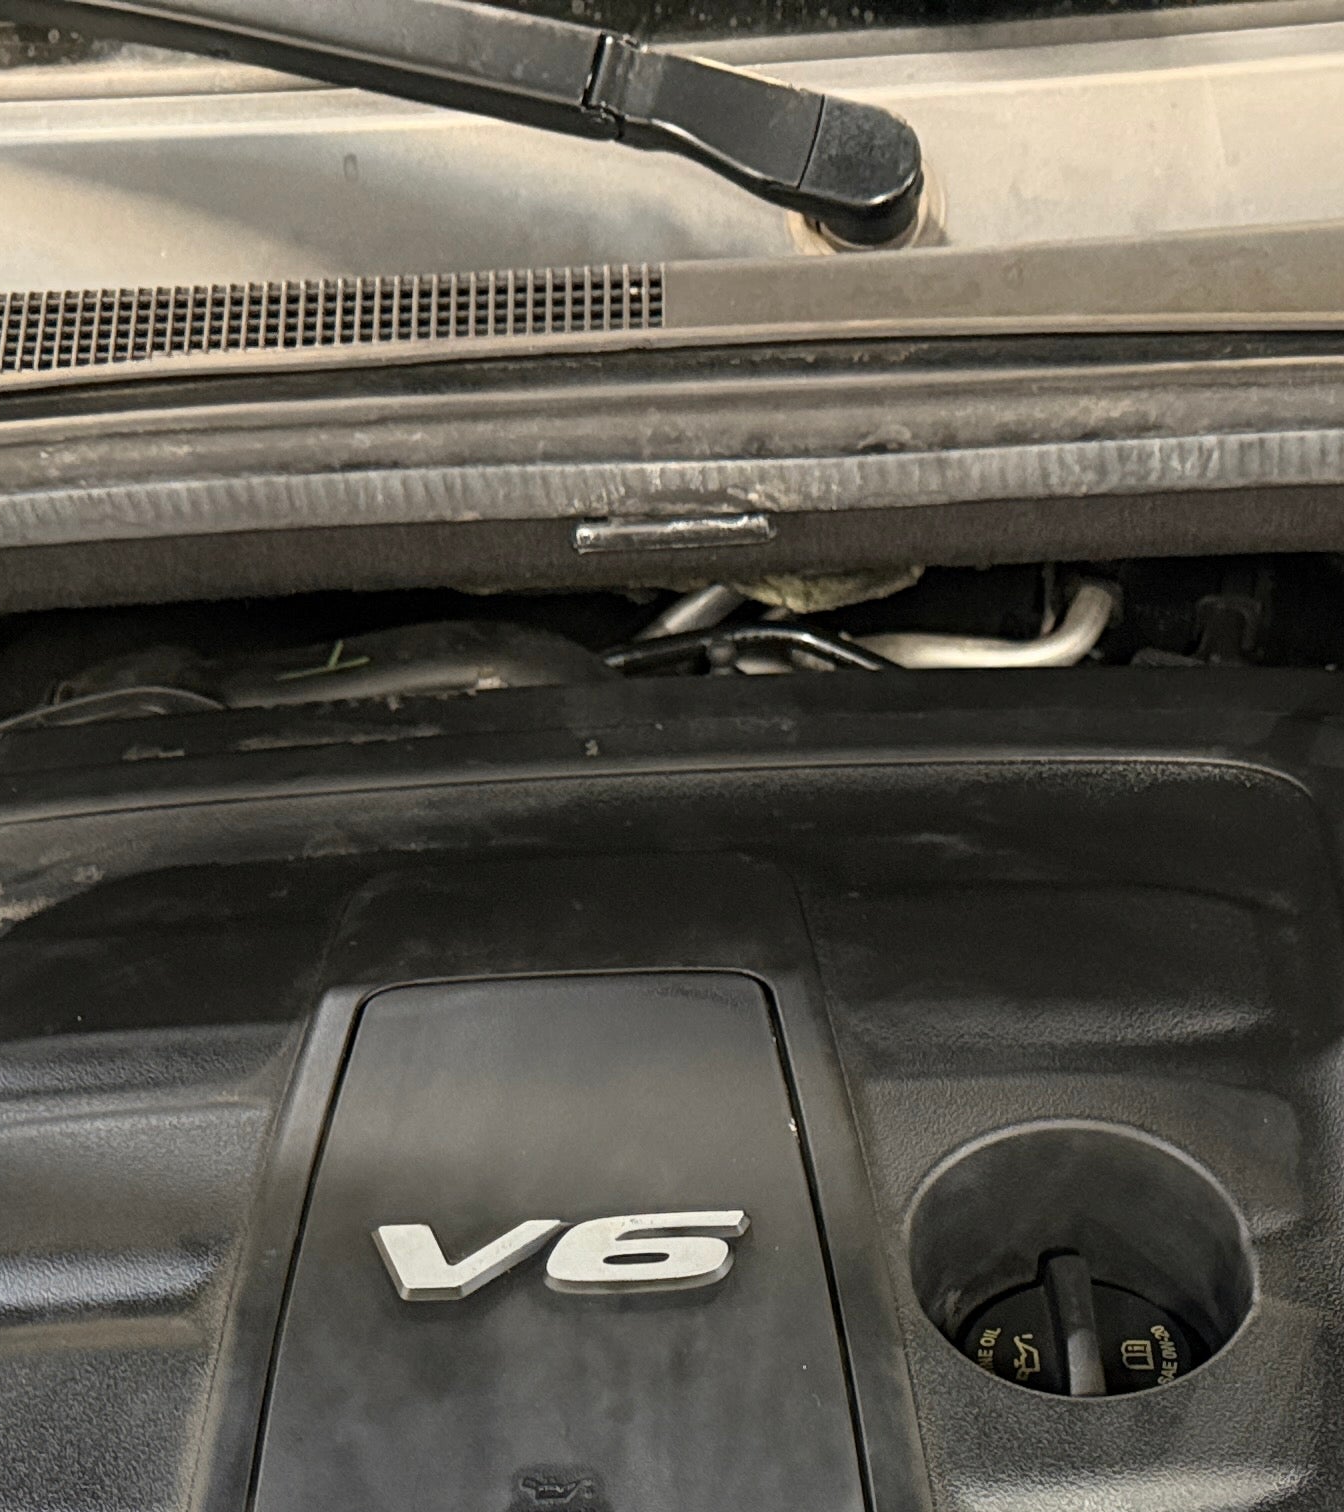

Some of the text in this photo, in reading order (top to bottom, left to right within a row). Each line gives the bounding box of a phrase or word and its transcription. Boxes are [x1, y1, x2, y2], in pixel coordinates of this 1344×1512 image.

[371, 1210, 750, 1300] V6
[979, 1328, 1002, 1347] OIL
[1150, 1325, 1178, 1385] SAE 0W-20
